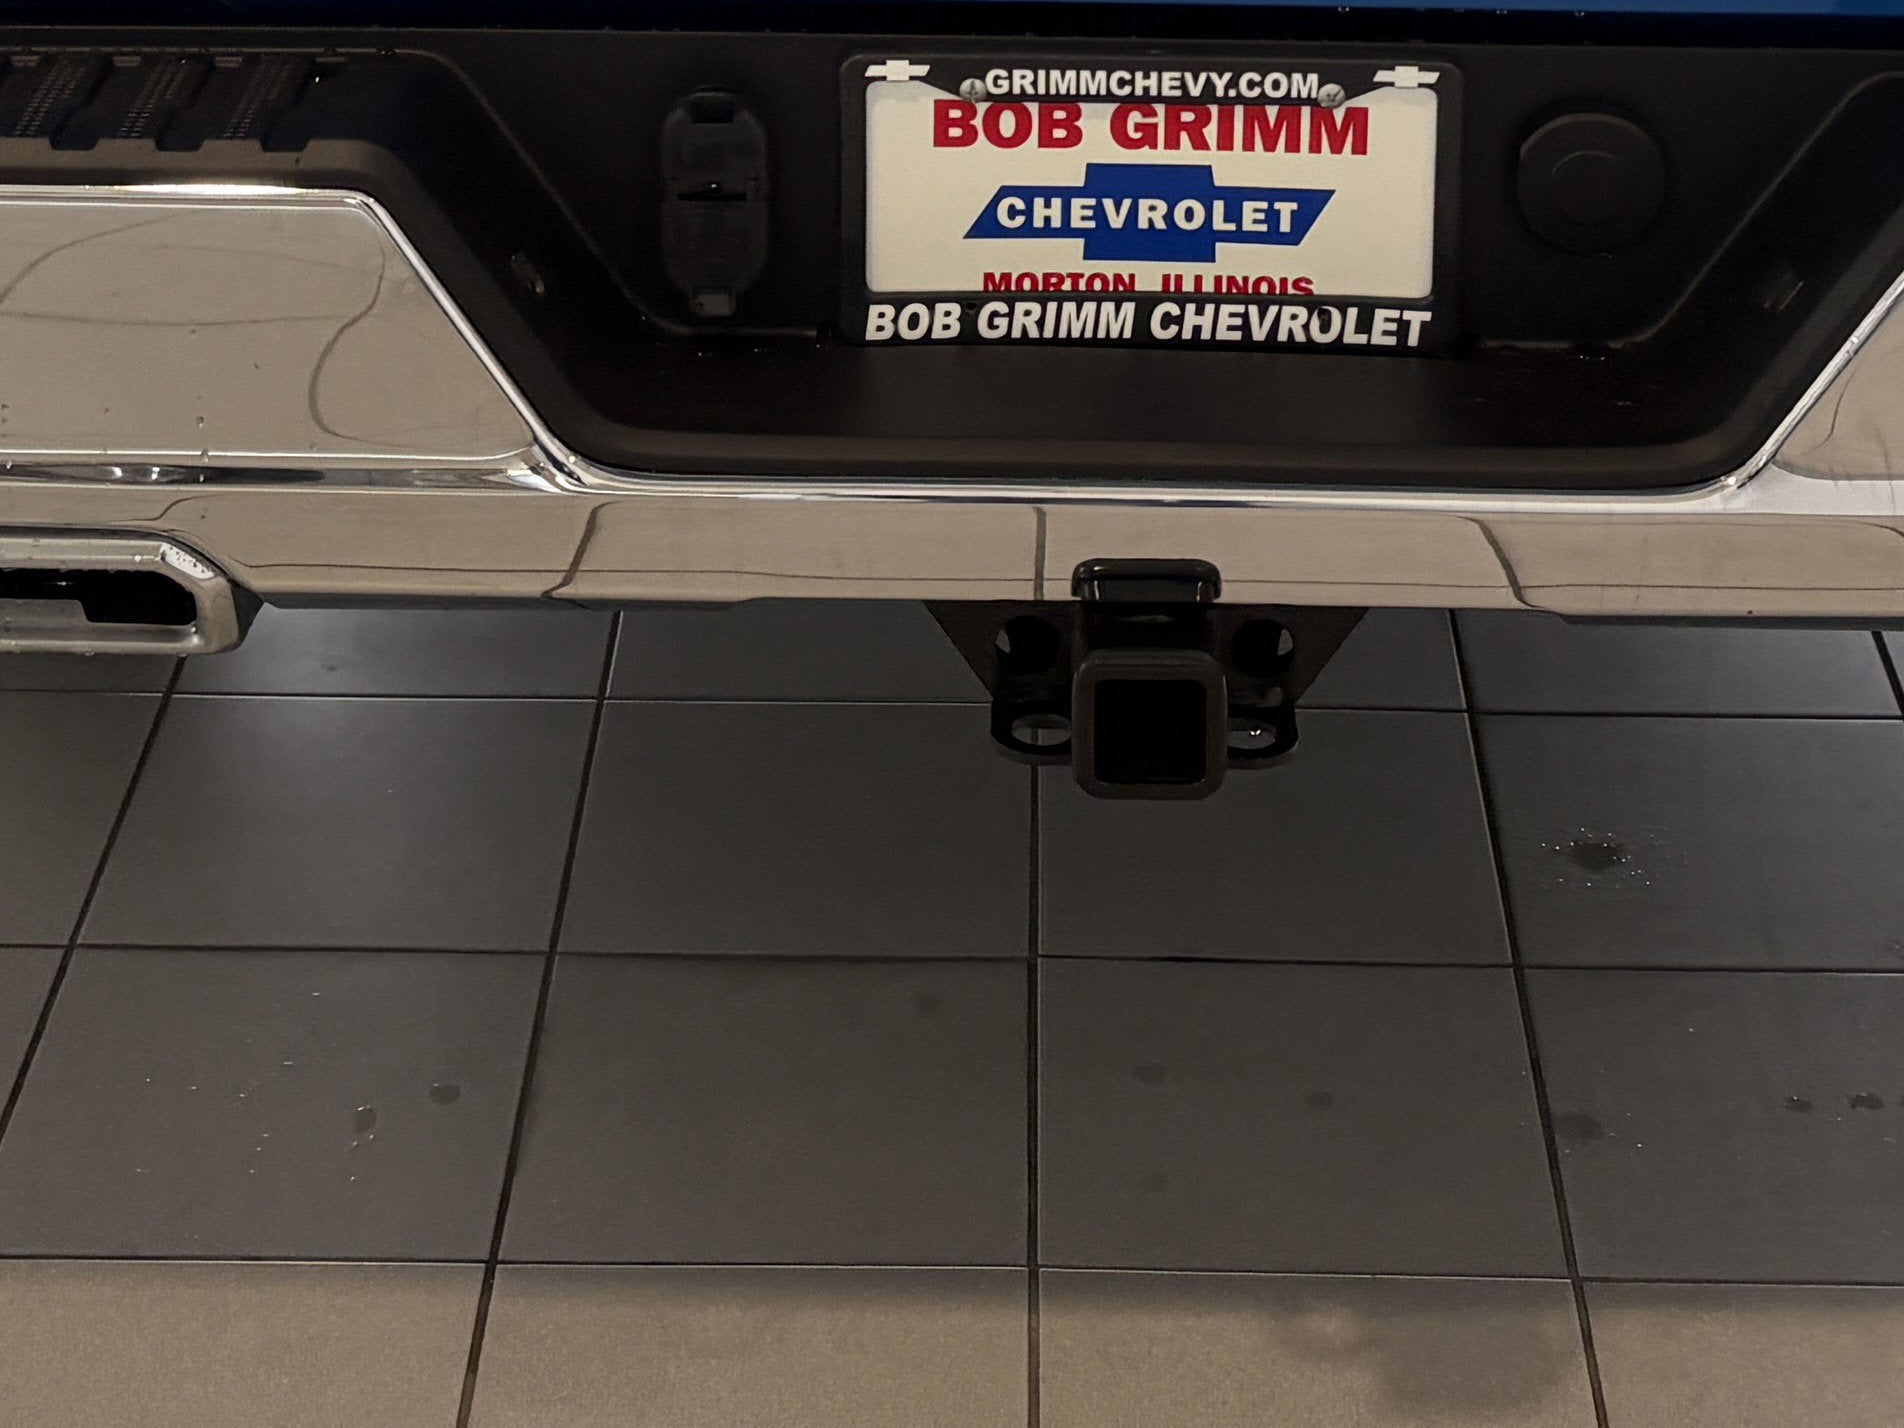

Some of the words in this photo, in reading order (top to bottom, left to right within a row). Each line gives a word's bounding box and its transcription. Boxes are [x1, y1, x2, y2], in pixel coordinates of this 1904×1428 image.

[984, 67, 1320, 100] GRIMMCHEVY.COM
[933, 99, 1084, 149] BOB
[1109, 102, 1369, 156] GRIMM
[996, 196, 1299, 233] CHEVROLET
[982, 271, 1137, 293] MORTON
[864, 302, 962, 342] BOB
[977, 300, 1137, 340] GRIMM
[1149, 301, 1434, 348] CHEVROLET
